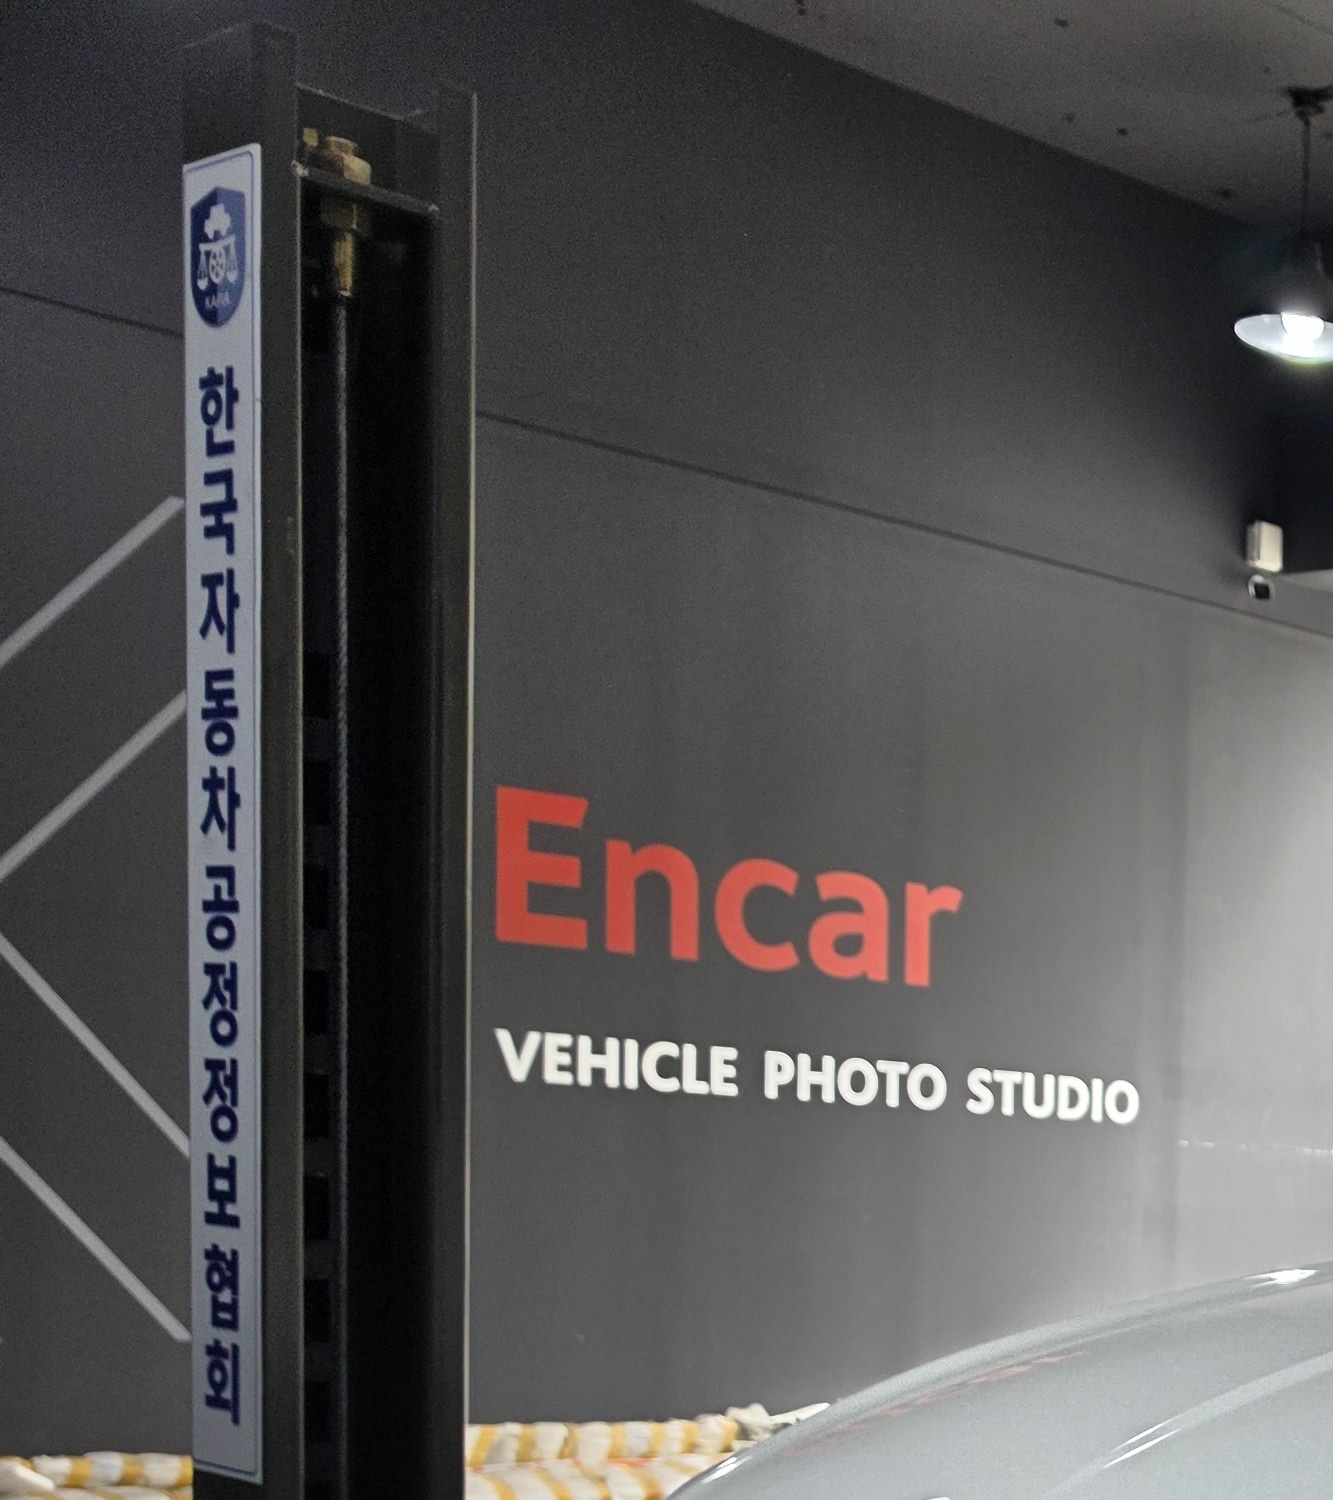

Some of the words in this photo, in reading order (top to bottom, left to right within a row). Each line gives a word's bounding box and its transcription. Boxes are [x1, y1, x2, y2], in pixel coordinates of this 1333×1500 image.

[199, 366, 240, 1427] 한국자동차공정정보협회
[495, 785, 964, 988] Encar
[494, 1027, 739, 1097] VEHICLE
[763, 1050, 948, 1111] PHOTO
[965, 1067, 1140, 1125] STUDIO
